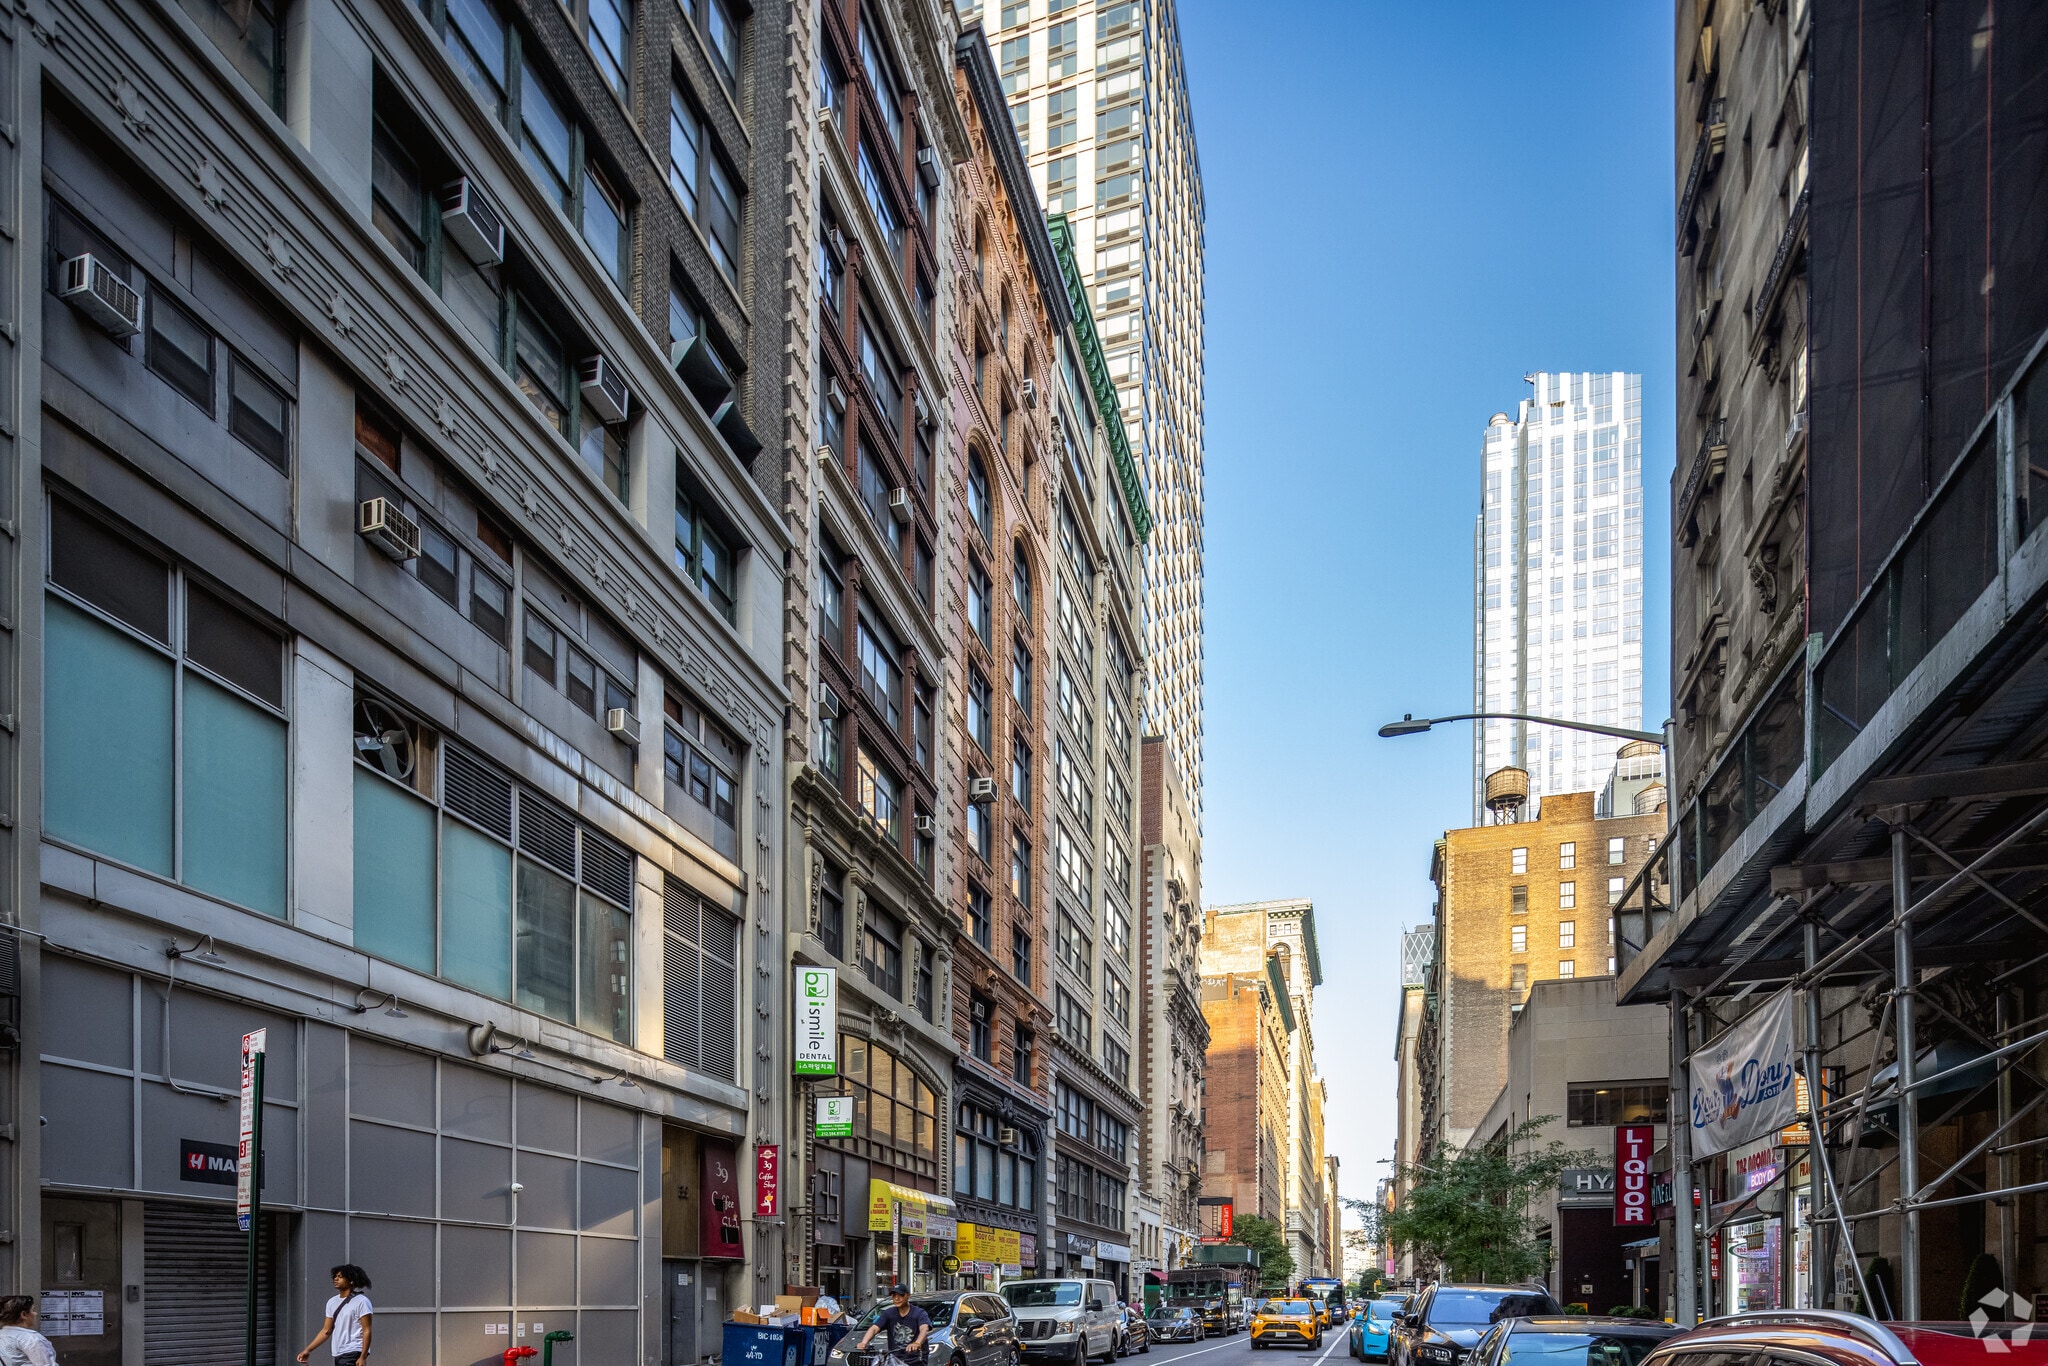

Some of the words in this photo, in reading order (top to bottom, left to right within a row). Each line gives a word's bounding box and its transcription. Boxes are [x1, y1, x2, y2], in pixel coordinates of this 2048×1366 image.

[799, 1052, 832, 1061] DENTAL
[1738, 1043, 1792, 1110] Donut
[240, 1141, 246, 1157] 3
[763, 1160, 773, 1171] 39
[1735, 1157, 1747, 1175] TAZ
[1747, 1147, 1771, 1171] AROMA
[715, 1161, 729, 1184] 39
[759, 1171, 774, 1181] Coffee
[1623, 1129, 1646, 1222] LIQUOR
[1750, 1171, 1767, 1188] BODY
[763, 1180, 777, 1190] Shop
[711, 1190, 735, 1211] Cffee
[975, 1232, 987, 1240] BODY
[987, 1234, 996, 1242] OIL
